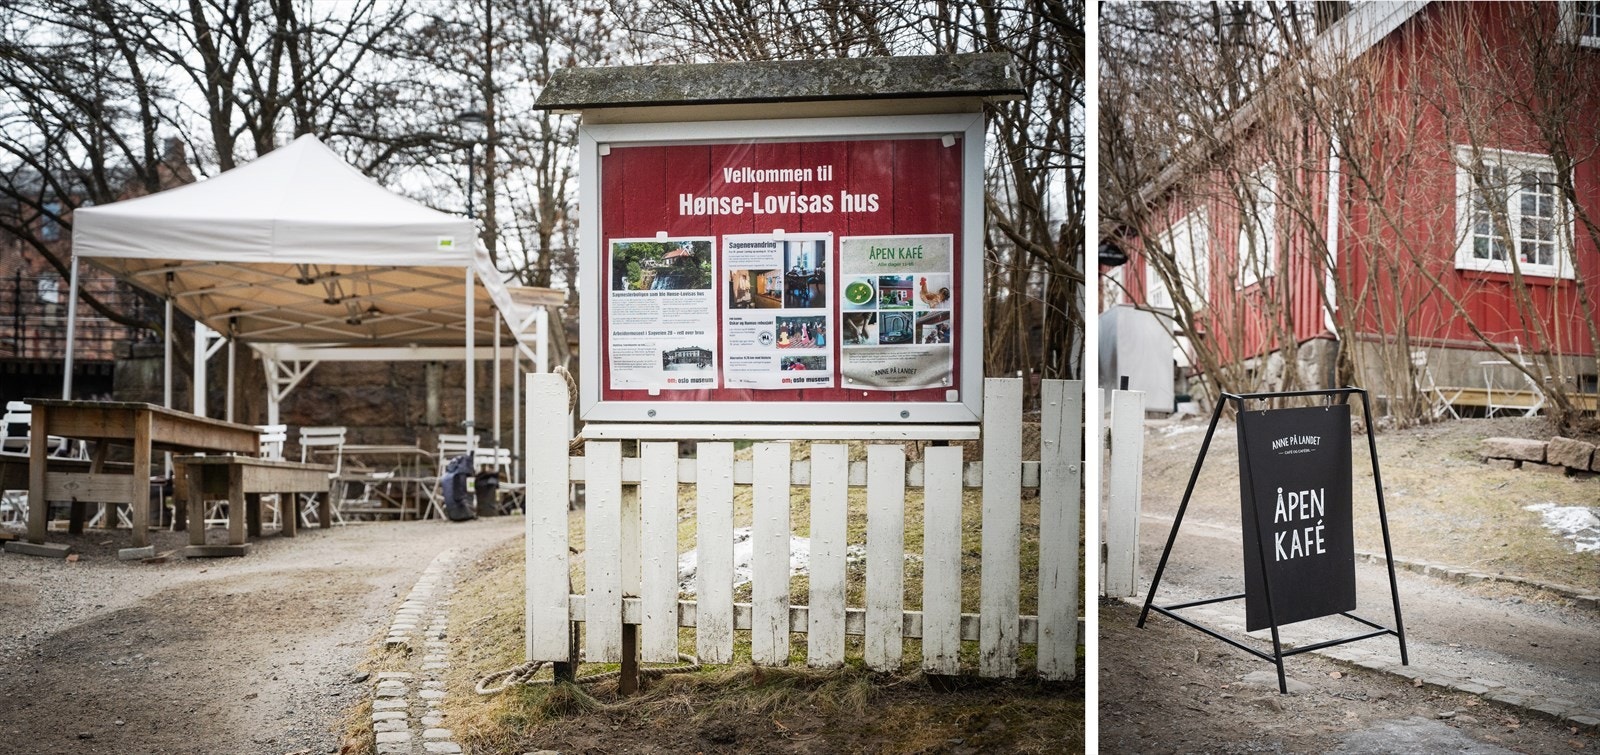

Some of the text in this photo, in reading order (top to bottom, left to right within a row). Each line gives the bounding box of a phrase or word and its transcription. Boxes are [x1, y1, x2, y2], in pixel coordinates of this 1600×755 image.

[723, 165, 833, 184] Velkommen til
[679, 190, 880, 216] Hønse-Lovisas hus
[728, 241, 777, 249] Sagenevandring
[869, 244, 923, 260] ÅPEN KAFÉ
[874, 368, 889, 376] ANNE
[890, 366, 897, 374] PÅ
[1272, 434, 1321, 451] ANNE PÅ LANDET
[1274, 487, 1325, 524] ÅPEN
[1274, 519, 1326, 562] KAFÉ
